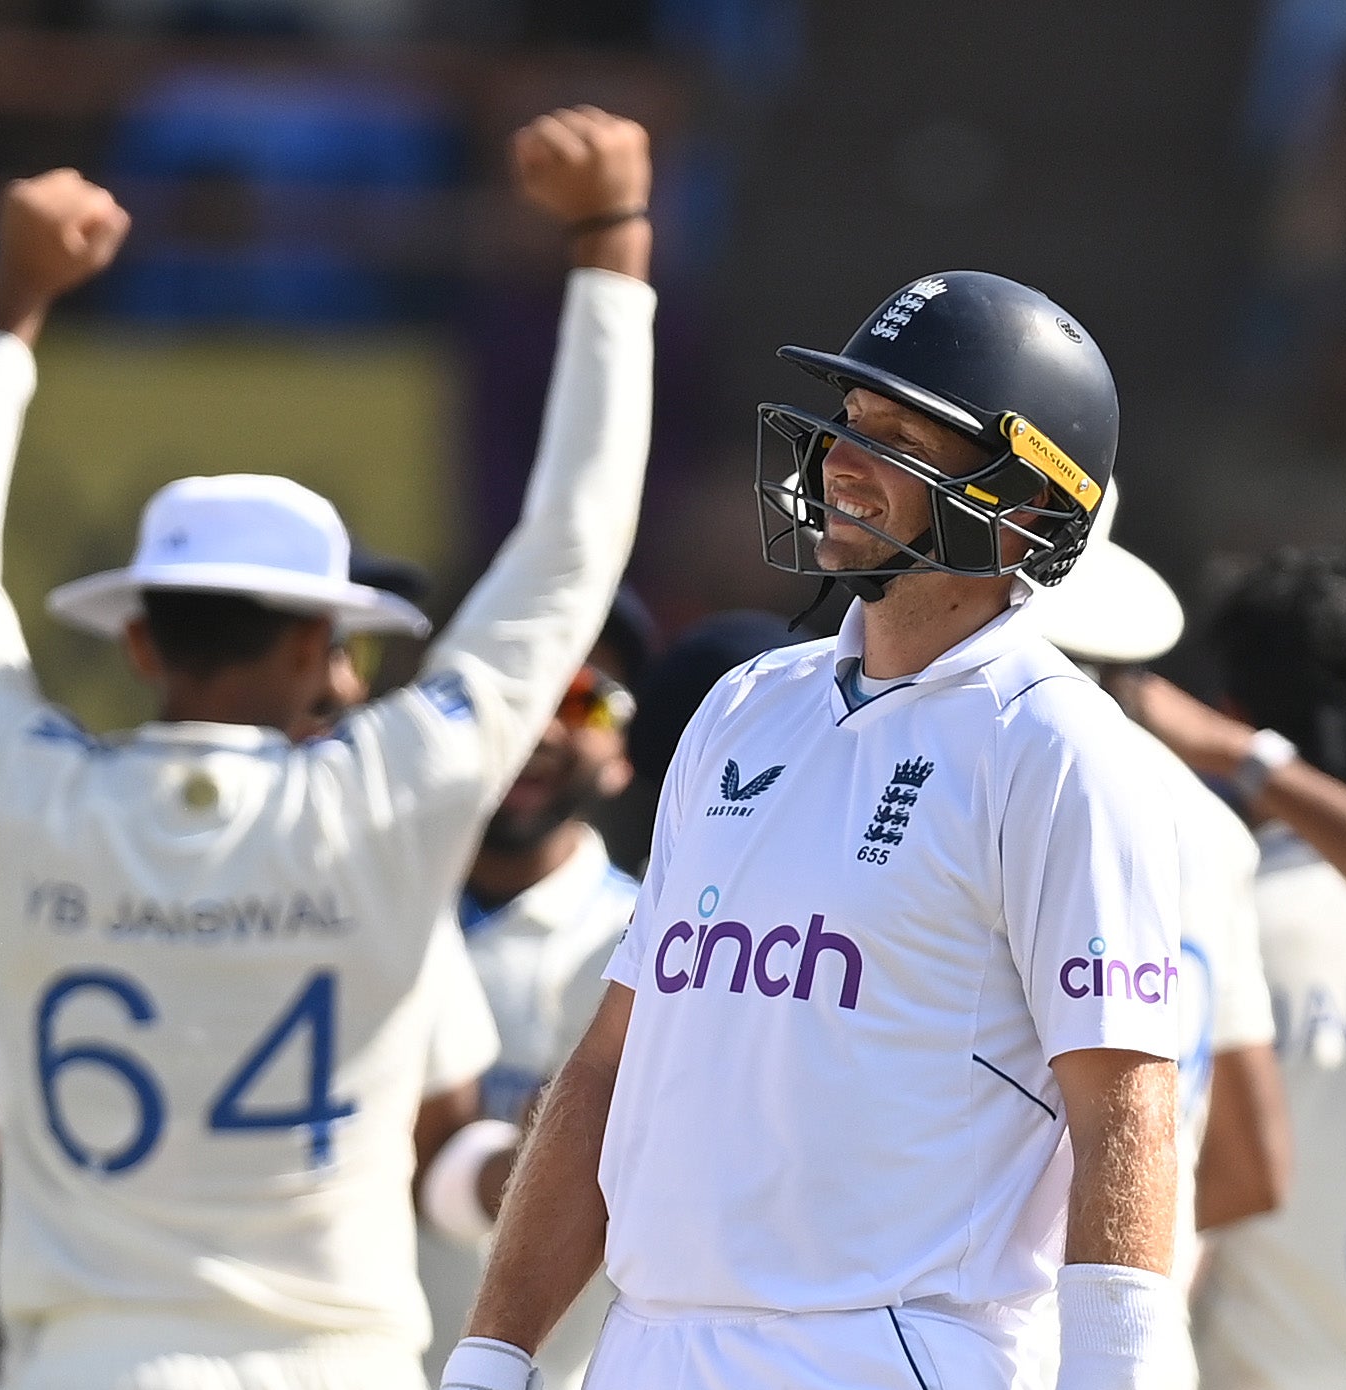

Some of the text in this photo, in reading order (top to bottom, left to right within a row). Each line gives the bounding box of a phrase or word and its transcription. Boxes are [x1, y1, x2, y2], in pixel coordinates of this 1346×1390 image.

[1027, 435, 1077, 481] MASURI
[856, 845, 891, 865] 655
[655, 885, 863, 1010] cinch
[1059, 937, 1179, 1005] cinch
[35, 966, 360, 1175] 64
